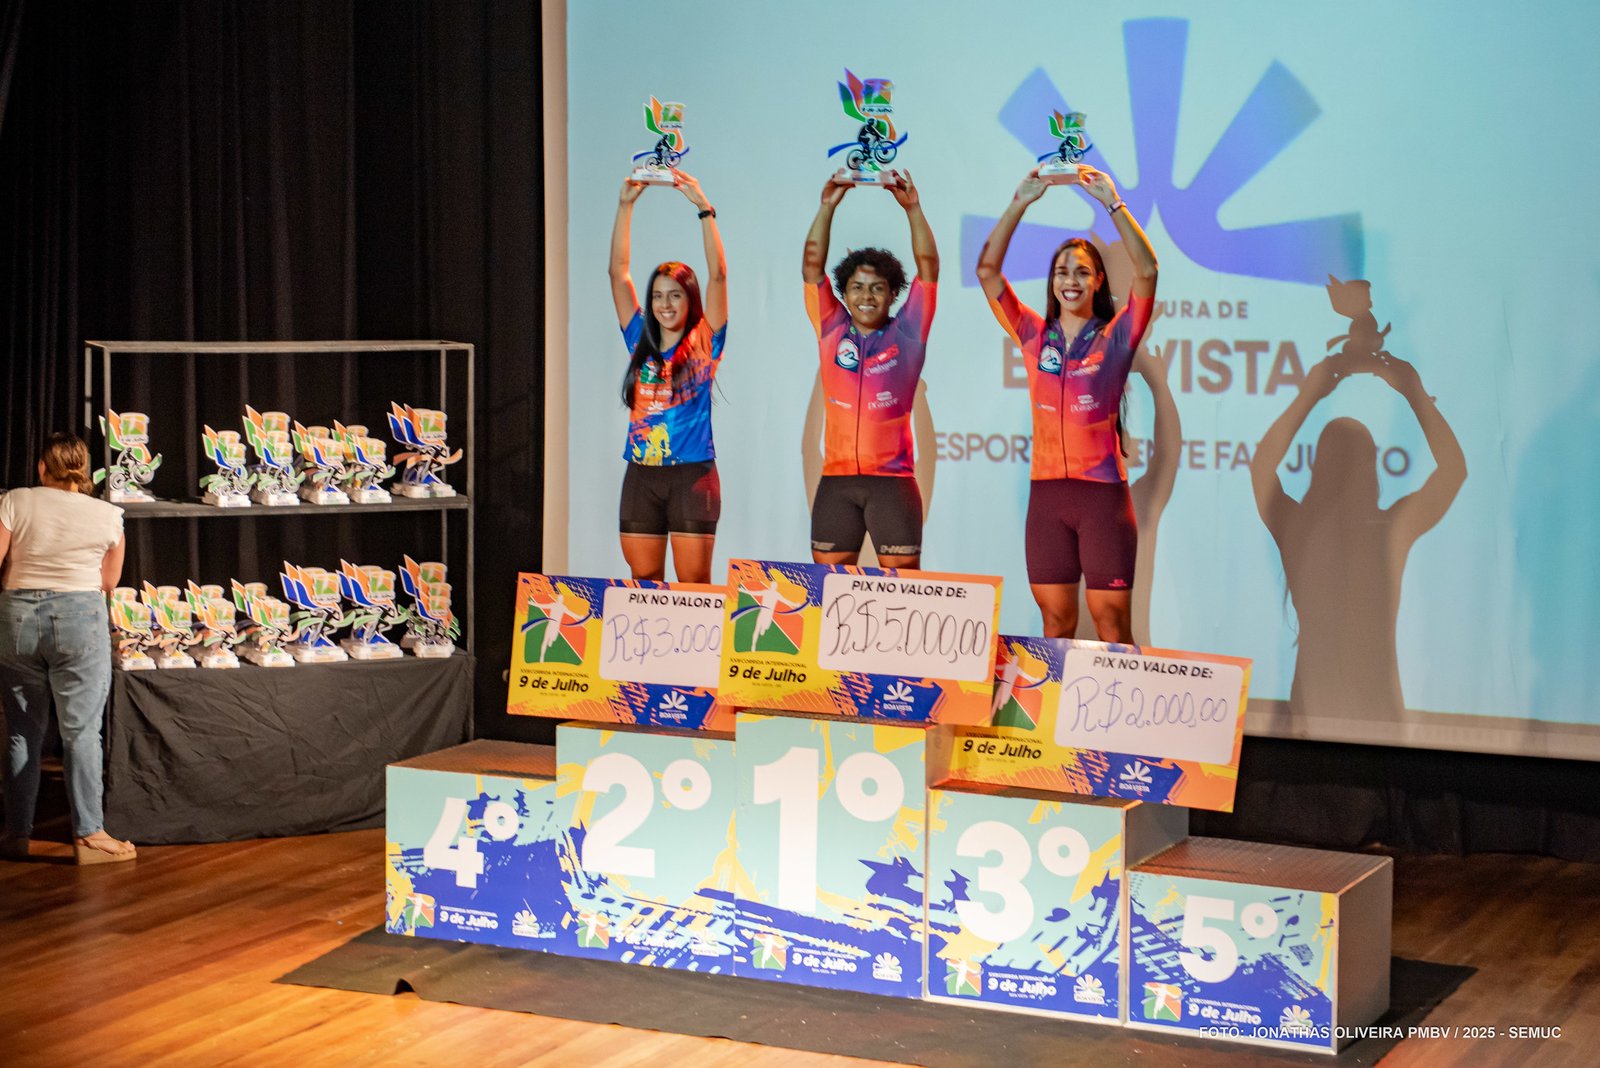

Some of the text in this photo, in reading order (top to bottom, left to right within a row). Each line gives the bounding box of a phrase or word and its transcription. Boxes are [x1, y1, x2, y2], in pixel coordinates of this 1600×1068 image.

[1218, 301, 1248, 318] DE
[935, 432, 1033, 463] ESPOR
[1215, 441, 1260, 470] FA
[851, 580, 967, 598] PIX NO VALOR DE:
[629, 593, 649, 605] PIX
[651, 594, 668, 606] NO
[671, 596, 711, 608] VALOR
[729, 665, 807, 683] 9 de Julho
[1093, 656, 1213, 679] PIX NO VALOR DE:
[519, 675, 589, 692] 9 de Julho
[963, 739, 1042, 759] 9 de Julho
[439, 910, 449, 922] 9
[449, 912, 465, 924] de
[466, 914, 498, 929] Julho
[792, 952, 802, 965] 9
[803, 954, 820, 967] de
[820, 956, 857, 973] Julho
[988, 977, 998, 990] 9
[999, 979, 1017, 992] de
[1018, 981, 1057, 996] Julho
[1188, 1003, 1199, 1016] 9
[1201, 1005, 1220, 1019] de
[1221, 1008, 1262, 1025] Julho
